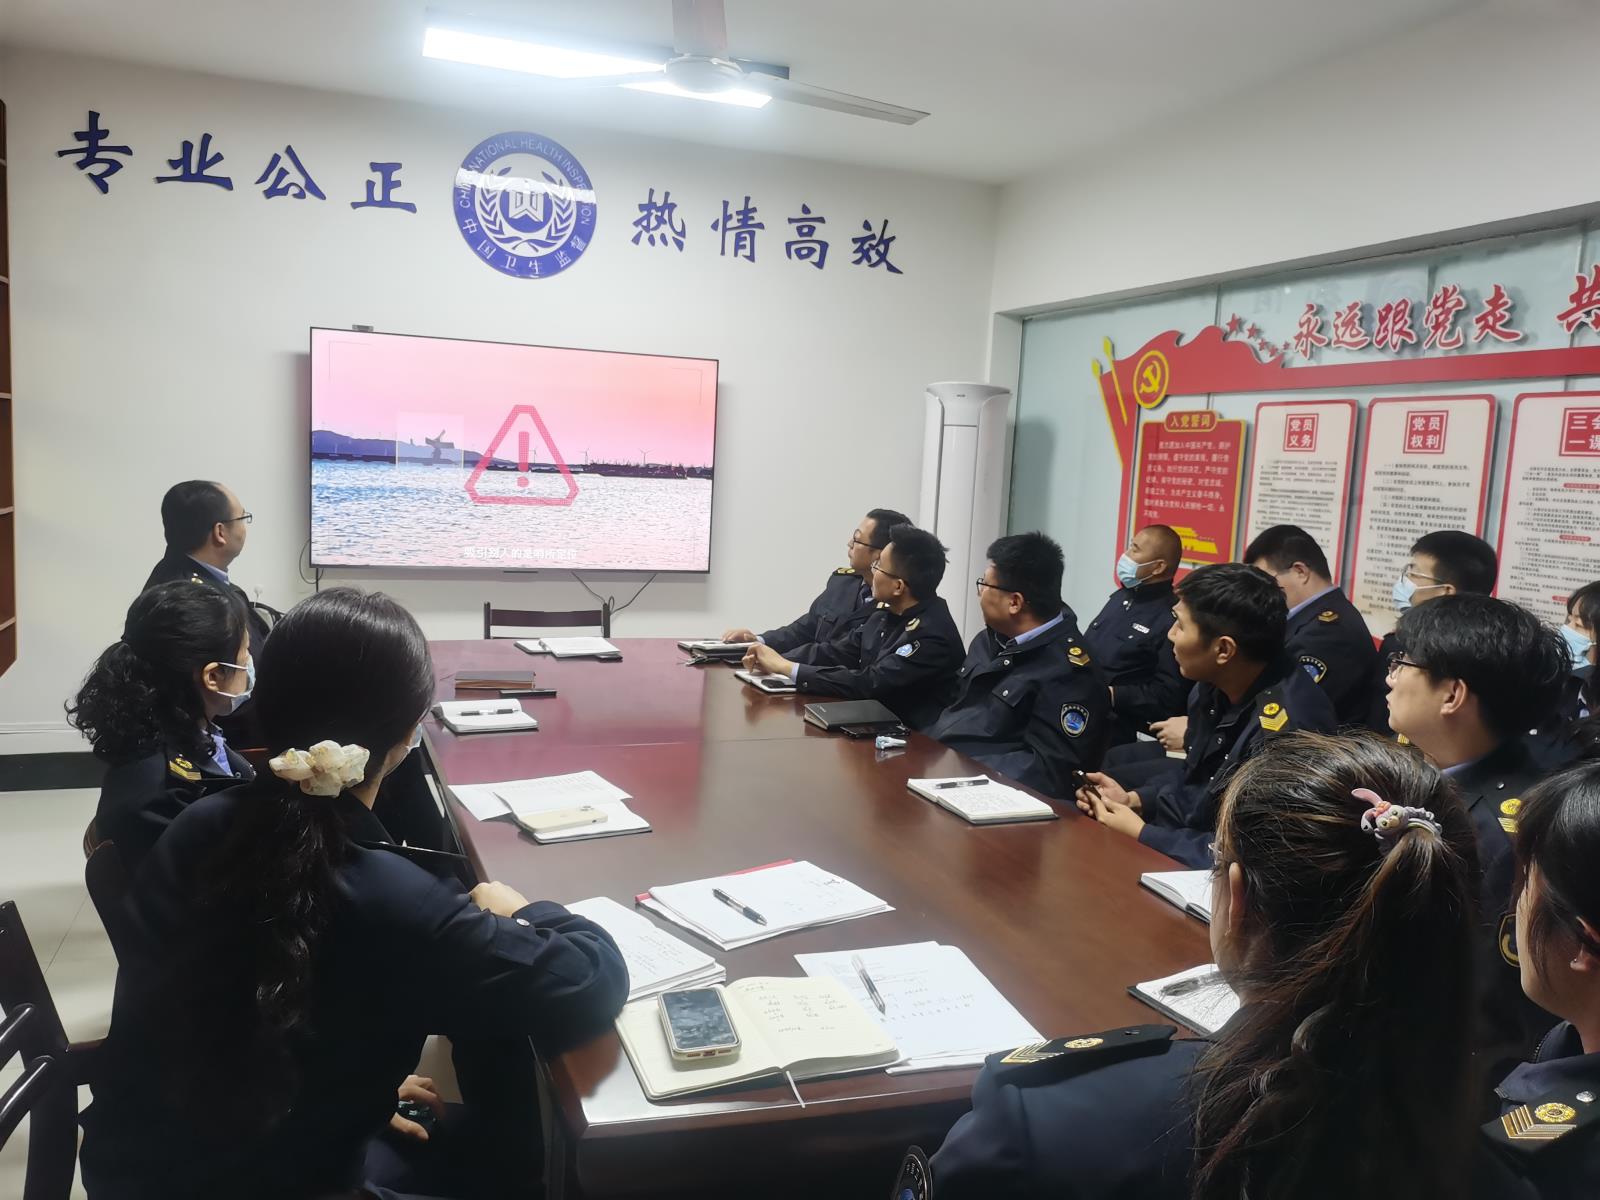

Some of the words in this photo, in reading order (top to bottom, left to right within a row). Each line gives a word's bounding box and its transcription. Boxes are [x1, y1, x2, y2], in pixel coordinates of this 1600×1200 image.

[57, 110, 417, 214] 专业公正
[468, 139, 518, 171] NATIONAL
[521, 139, 563, 162] HEALTH
[560, 157, 592, 226] INSPEION
[463, 218, 587, 278] 中国卫生监督
[632, 187, 904, 275] 热情高效
[1293, 283, 1522, 359] 永远跟党走
[1170, 414, 1211, 428] 入党誓词
[1290, 419, 1313, 432] 党员
[1412, 416, 1441, 431] 党员
[1289, 434, 1312, 448] 义务
[1410, 434, 1440, 448] 权利
